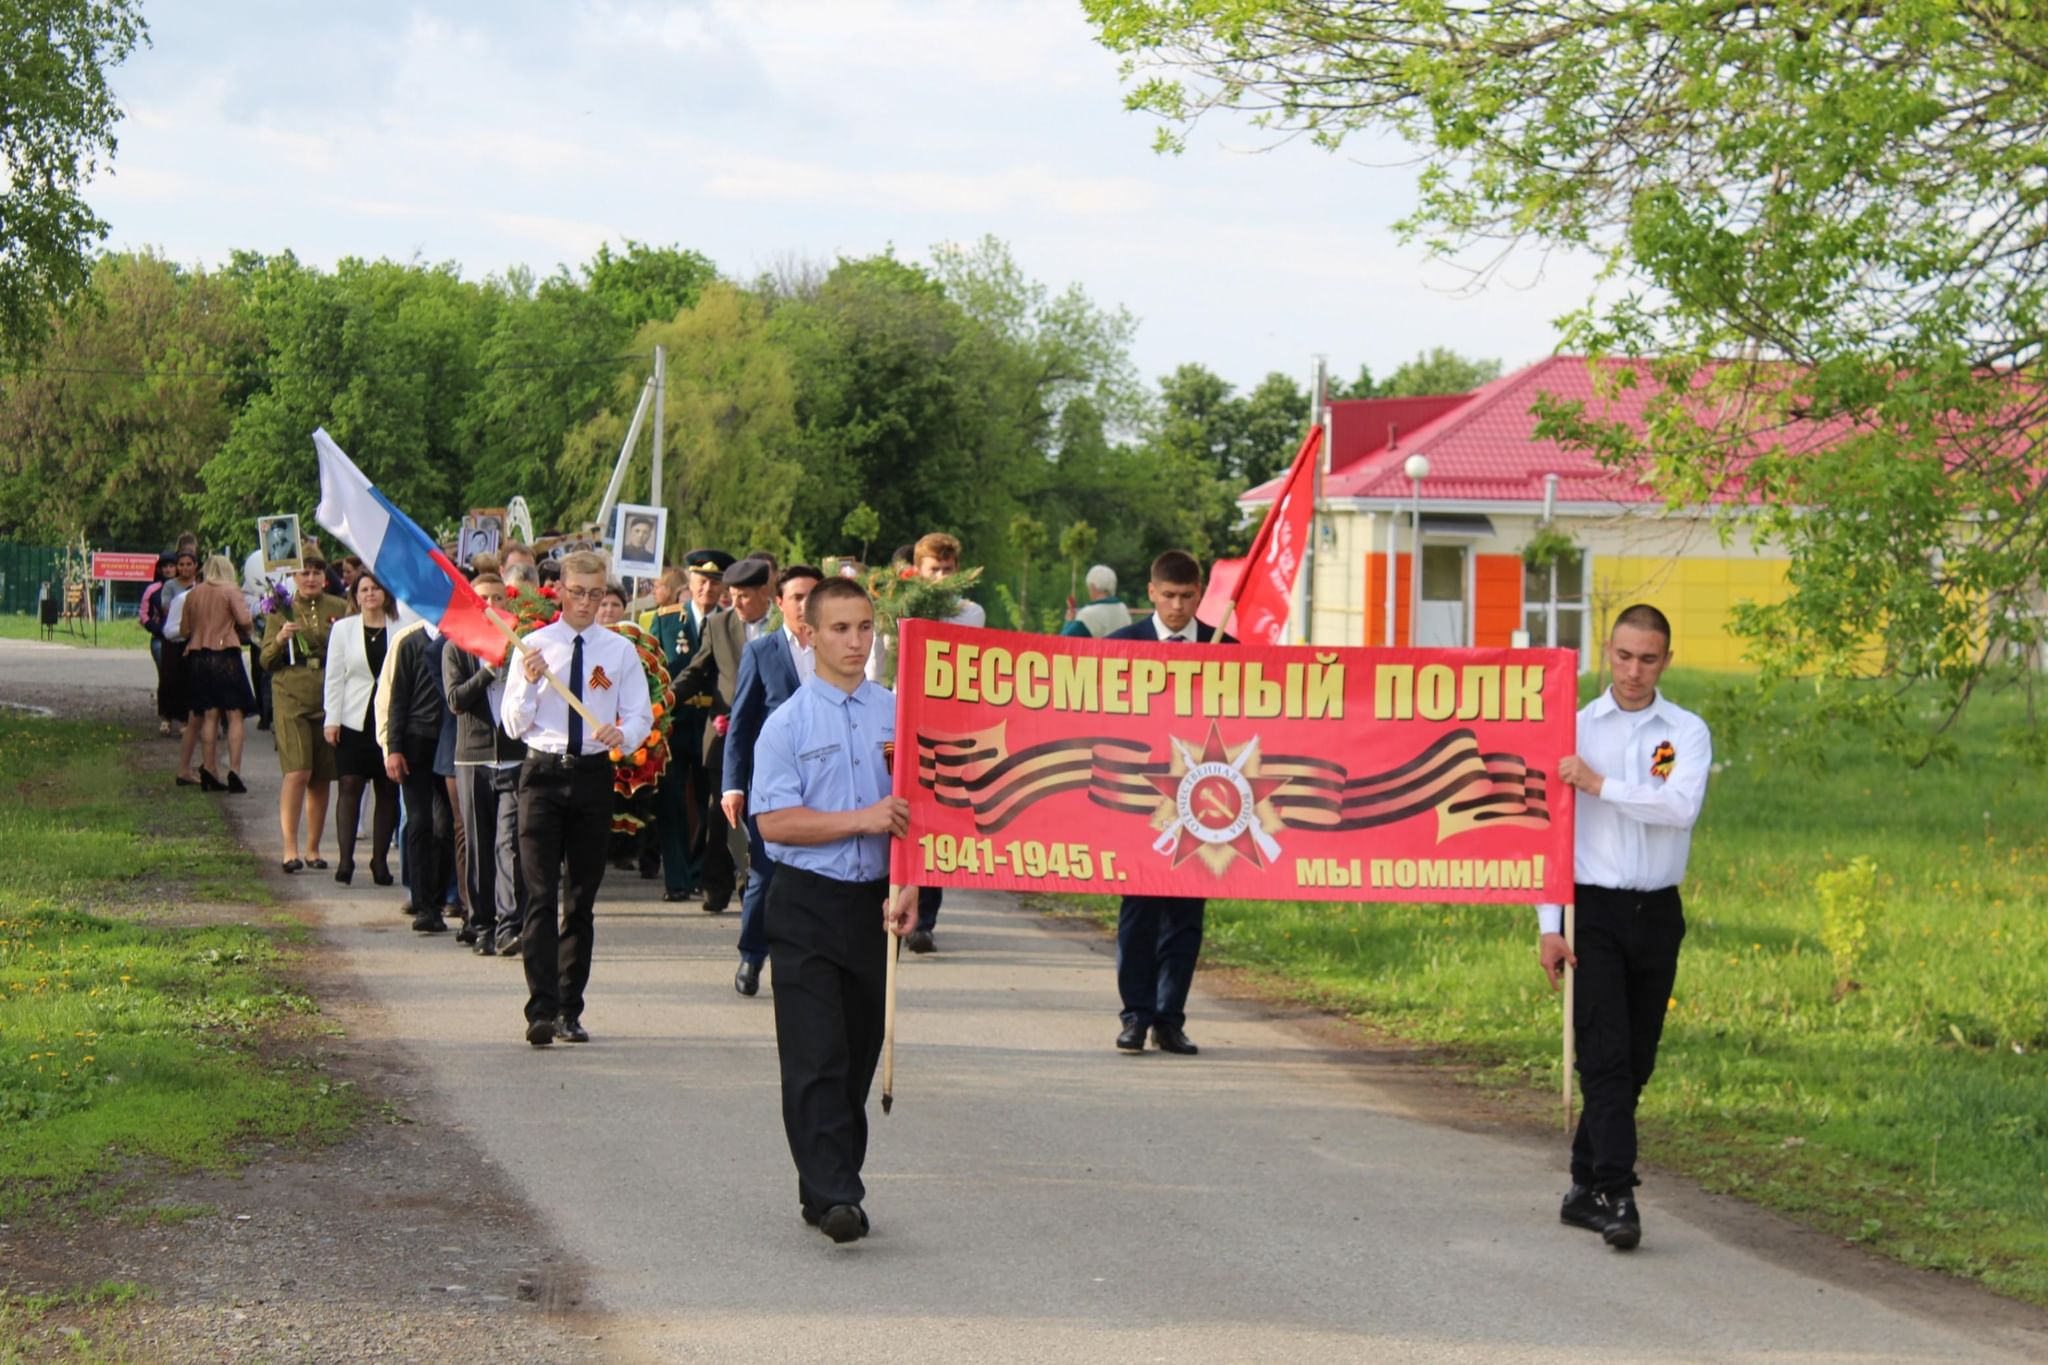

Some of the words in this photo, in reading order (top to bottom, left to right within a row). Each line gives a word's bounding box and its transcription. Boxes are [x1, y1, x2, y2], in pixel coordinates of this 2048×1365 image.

[923, 639, 1345, 719] БЕССМЕРТНЫЙ
[1374, 664, 1545, 721] ПОЛК
[1180, 764, 1239, 834] ОТЕЧЕСТВЕННАЯ
[918, 833, 1093, 880] 1941-1945
[1100, 851, 1127, 881] г.
